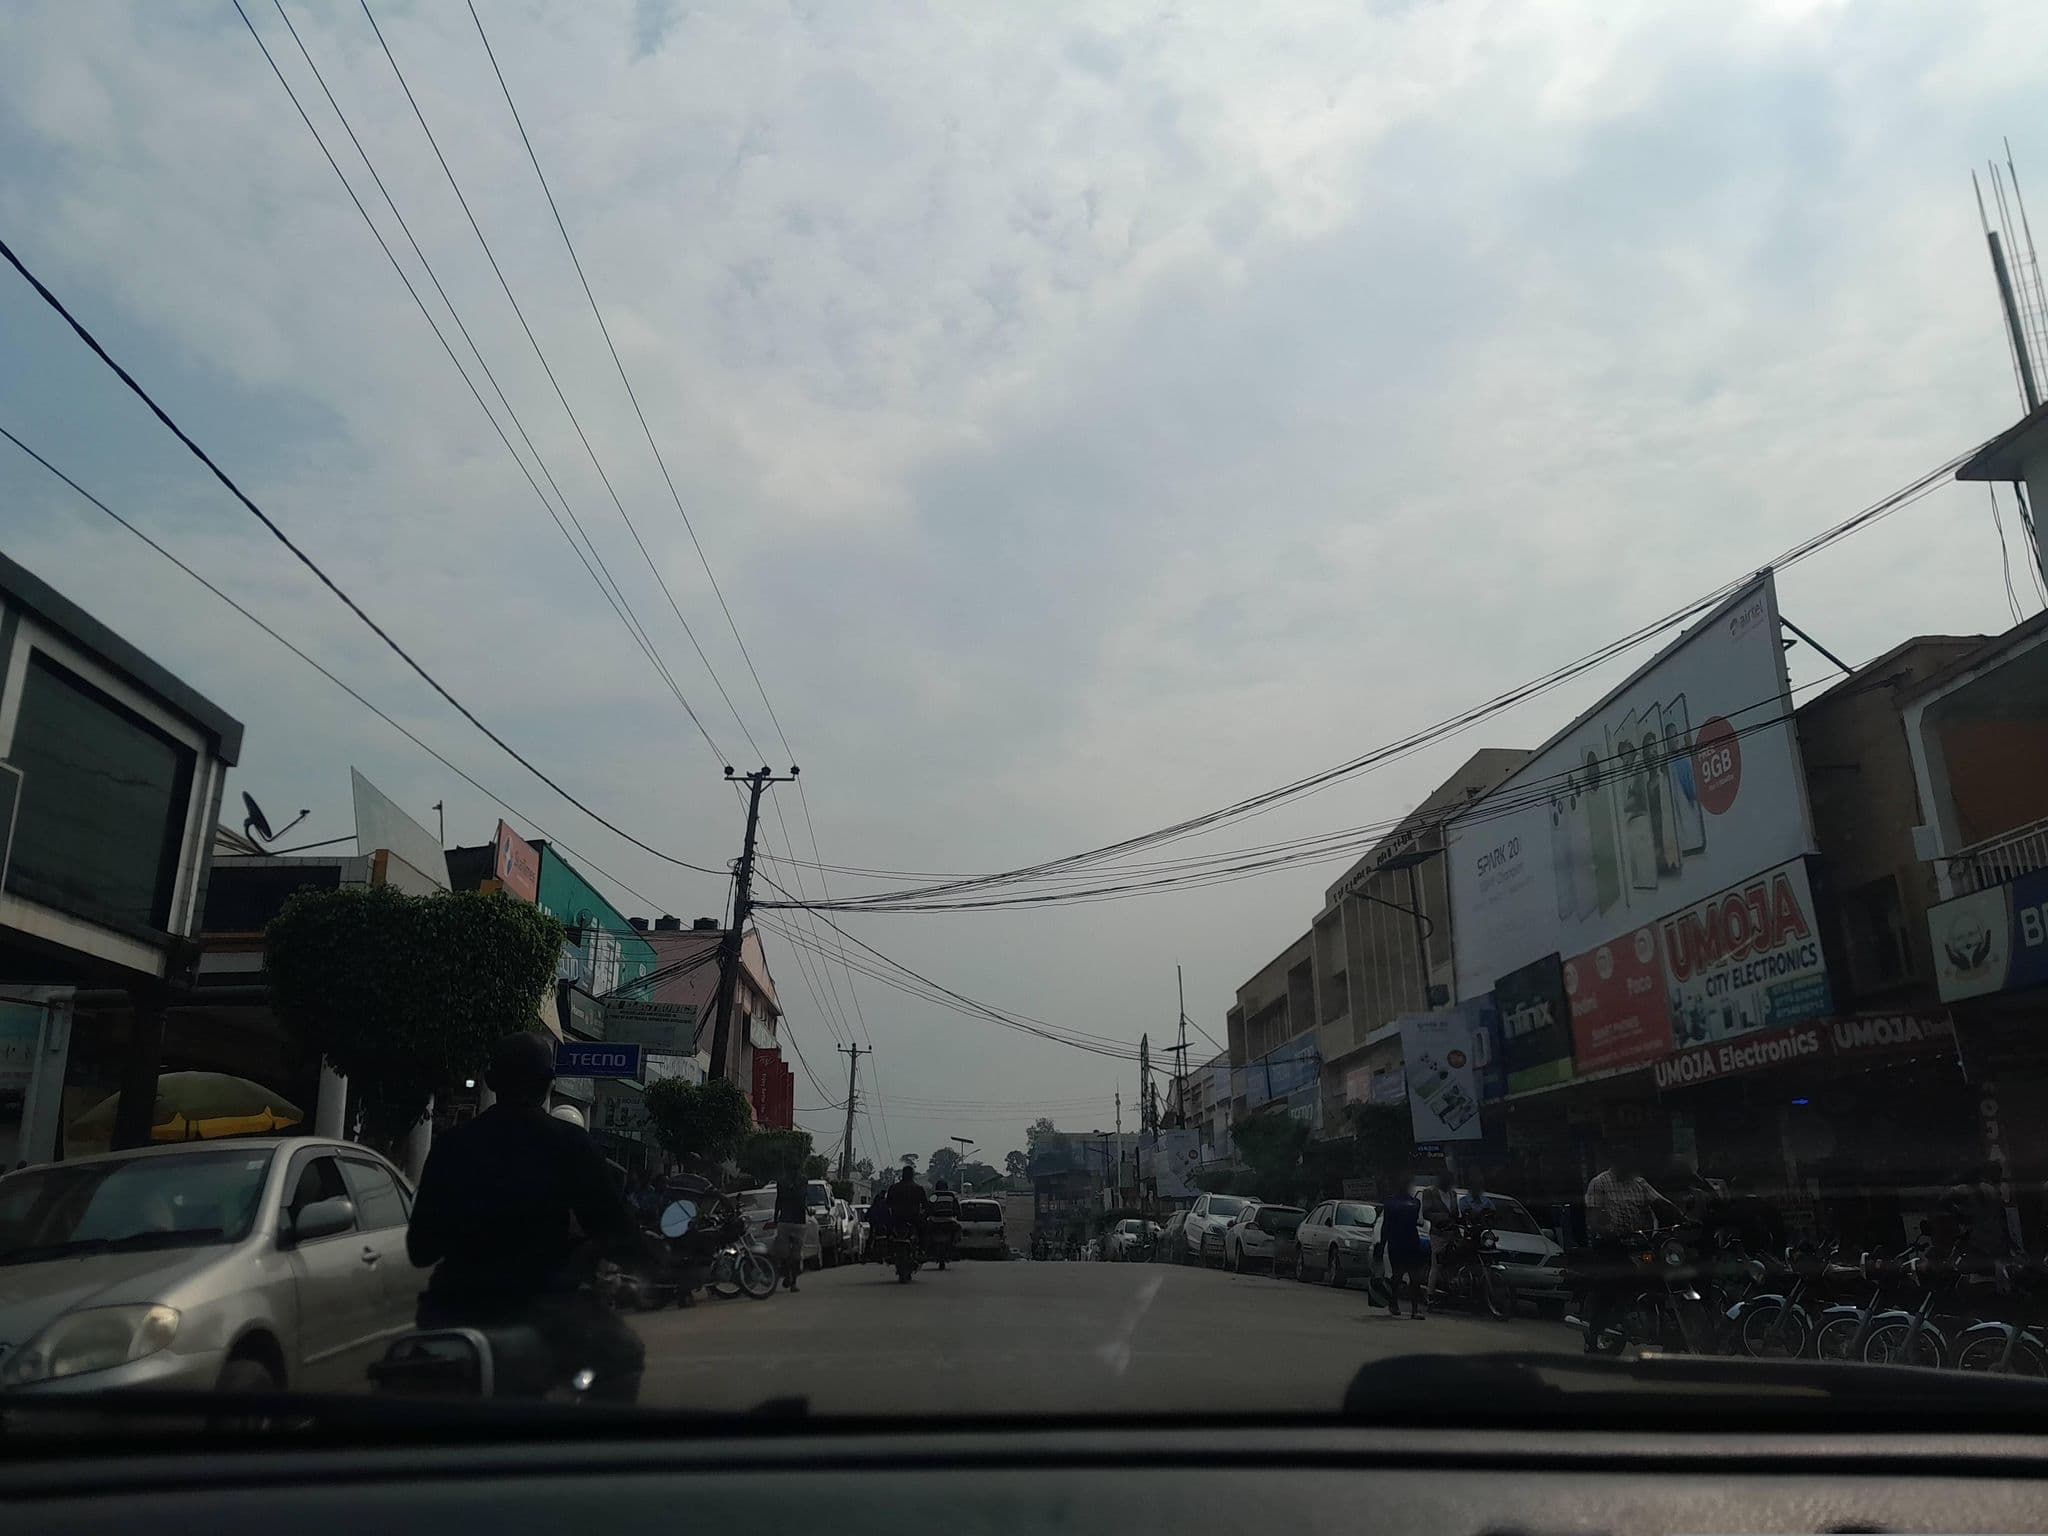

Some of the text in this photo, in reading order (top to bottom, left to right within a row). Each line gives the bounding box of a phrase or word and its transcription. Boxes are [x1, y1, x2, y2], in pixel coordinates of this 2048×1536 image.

[1702, 748, 1732, 783] 9GB
[1477, 844, 1506, 877] SPARK
[1507, 836, 1520, 860] 20
[1664, 872, 1812, 984] UMOJA
[2019, 901, 2048, 949] B
[1706, 973, 1731, 998] CITY
[1733, 943, 1818, 990] ELECTRONICS
[1833, 1015, 1925, 1049] UMOJA
[569, 1052, 627, 1068] TECNO
[1654, 1050, 1717, 1088] UMOJA
[1719, 1028, 1819, 1073] Electronics
